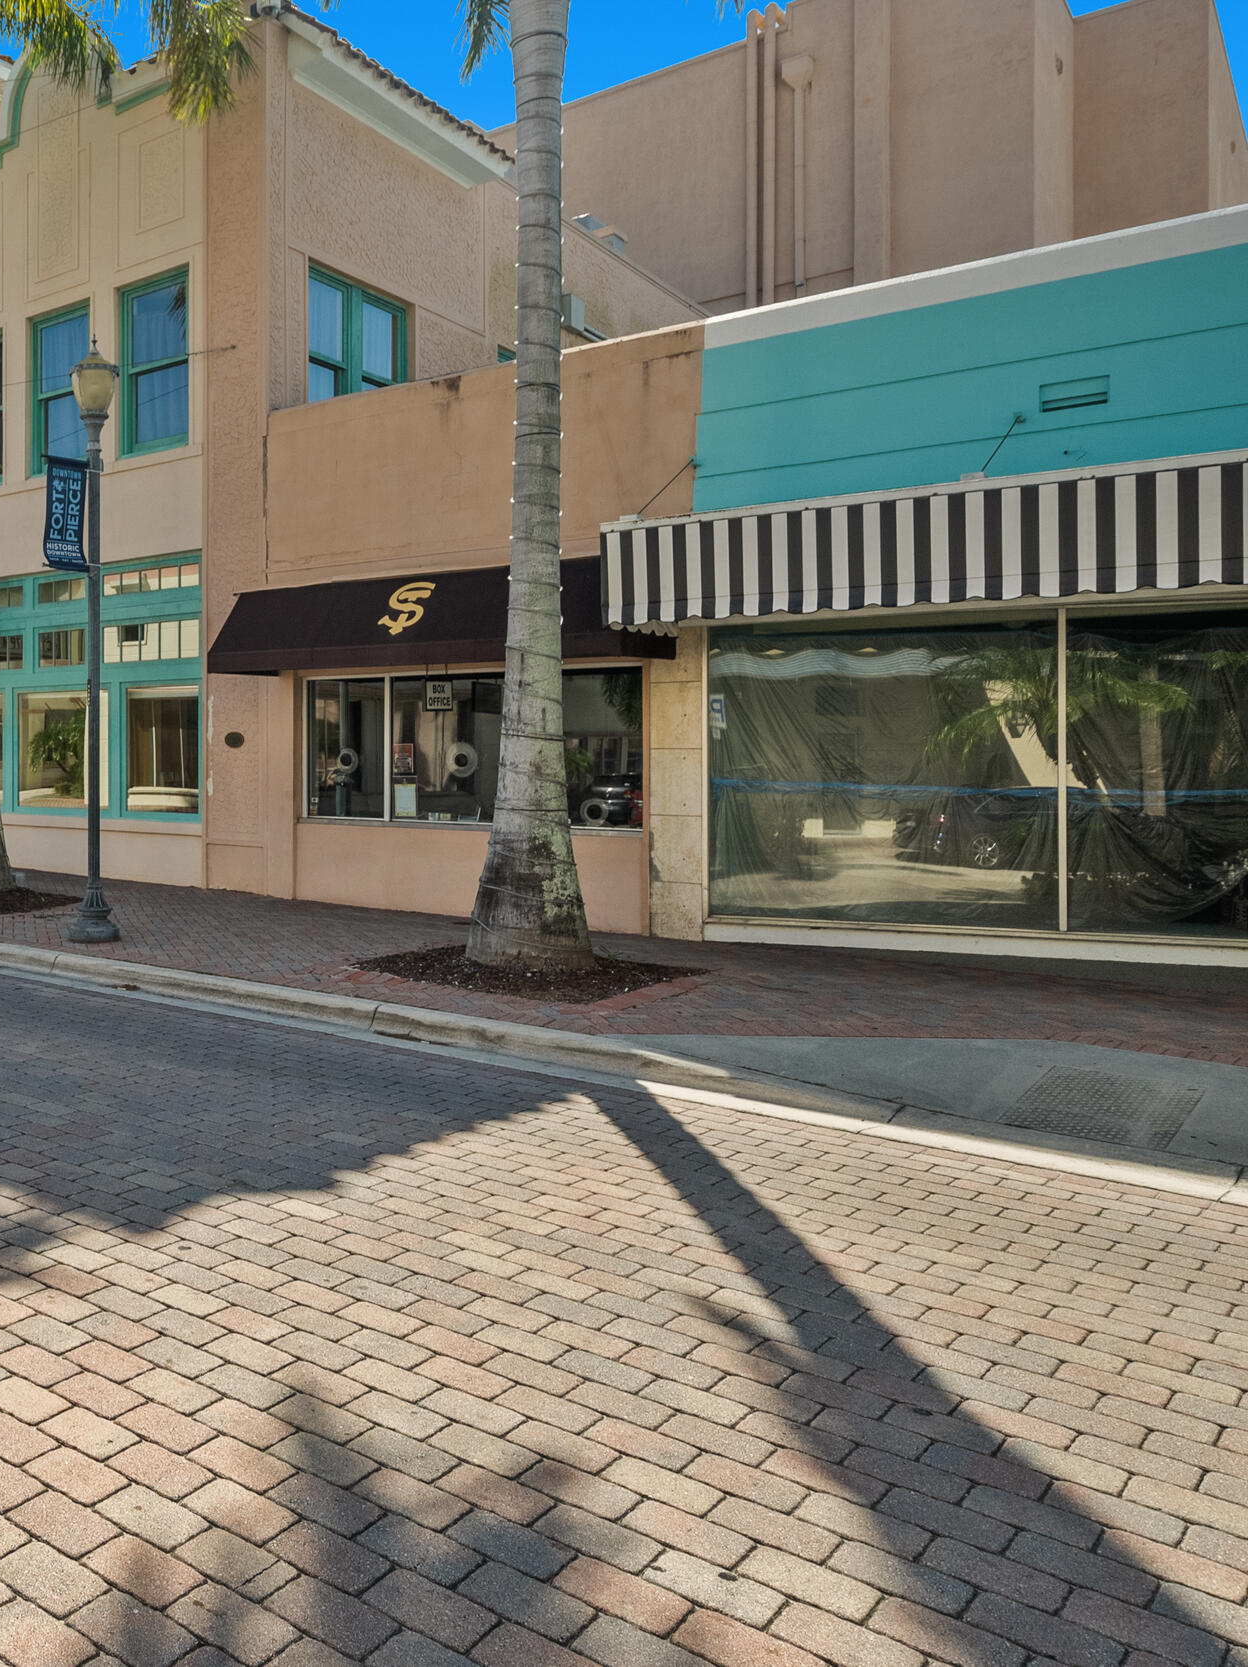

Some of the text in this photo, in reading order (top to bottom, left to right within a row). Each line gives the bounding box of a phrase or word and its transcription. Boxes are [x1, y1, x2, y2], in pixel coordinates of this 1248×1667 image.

[49, 489, 65, 540] FORT
[66, 479, 82, 541] PIERCE
[46, 542, 80, 552] HISTORIC
[432, 684, 446, 694] BOX
[428, 696, 451, 707] OFFICE
